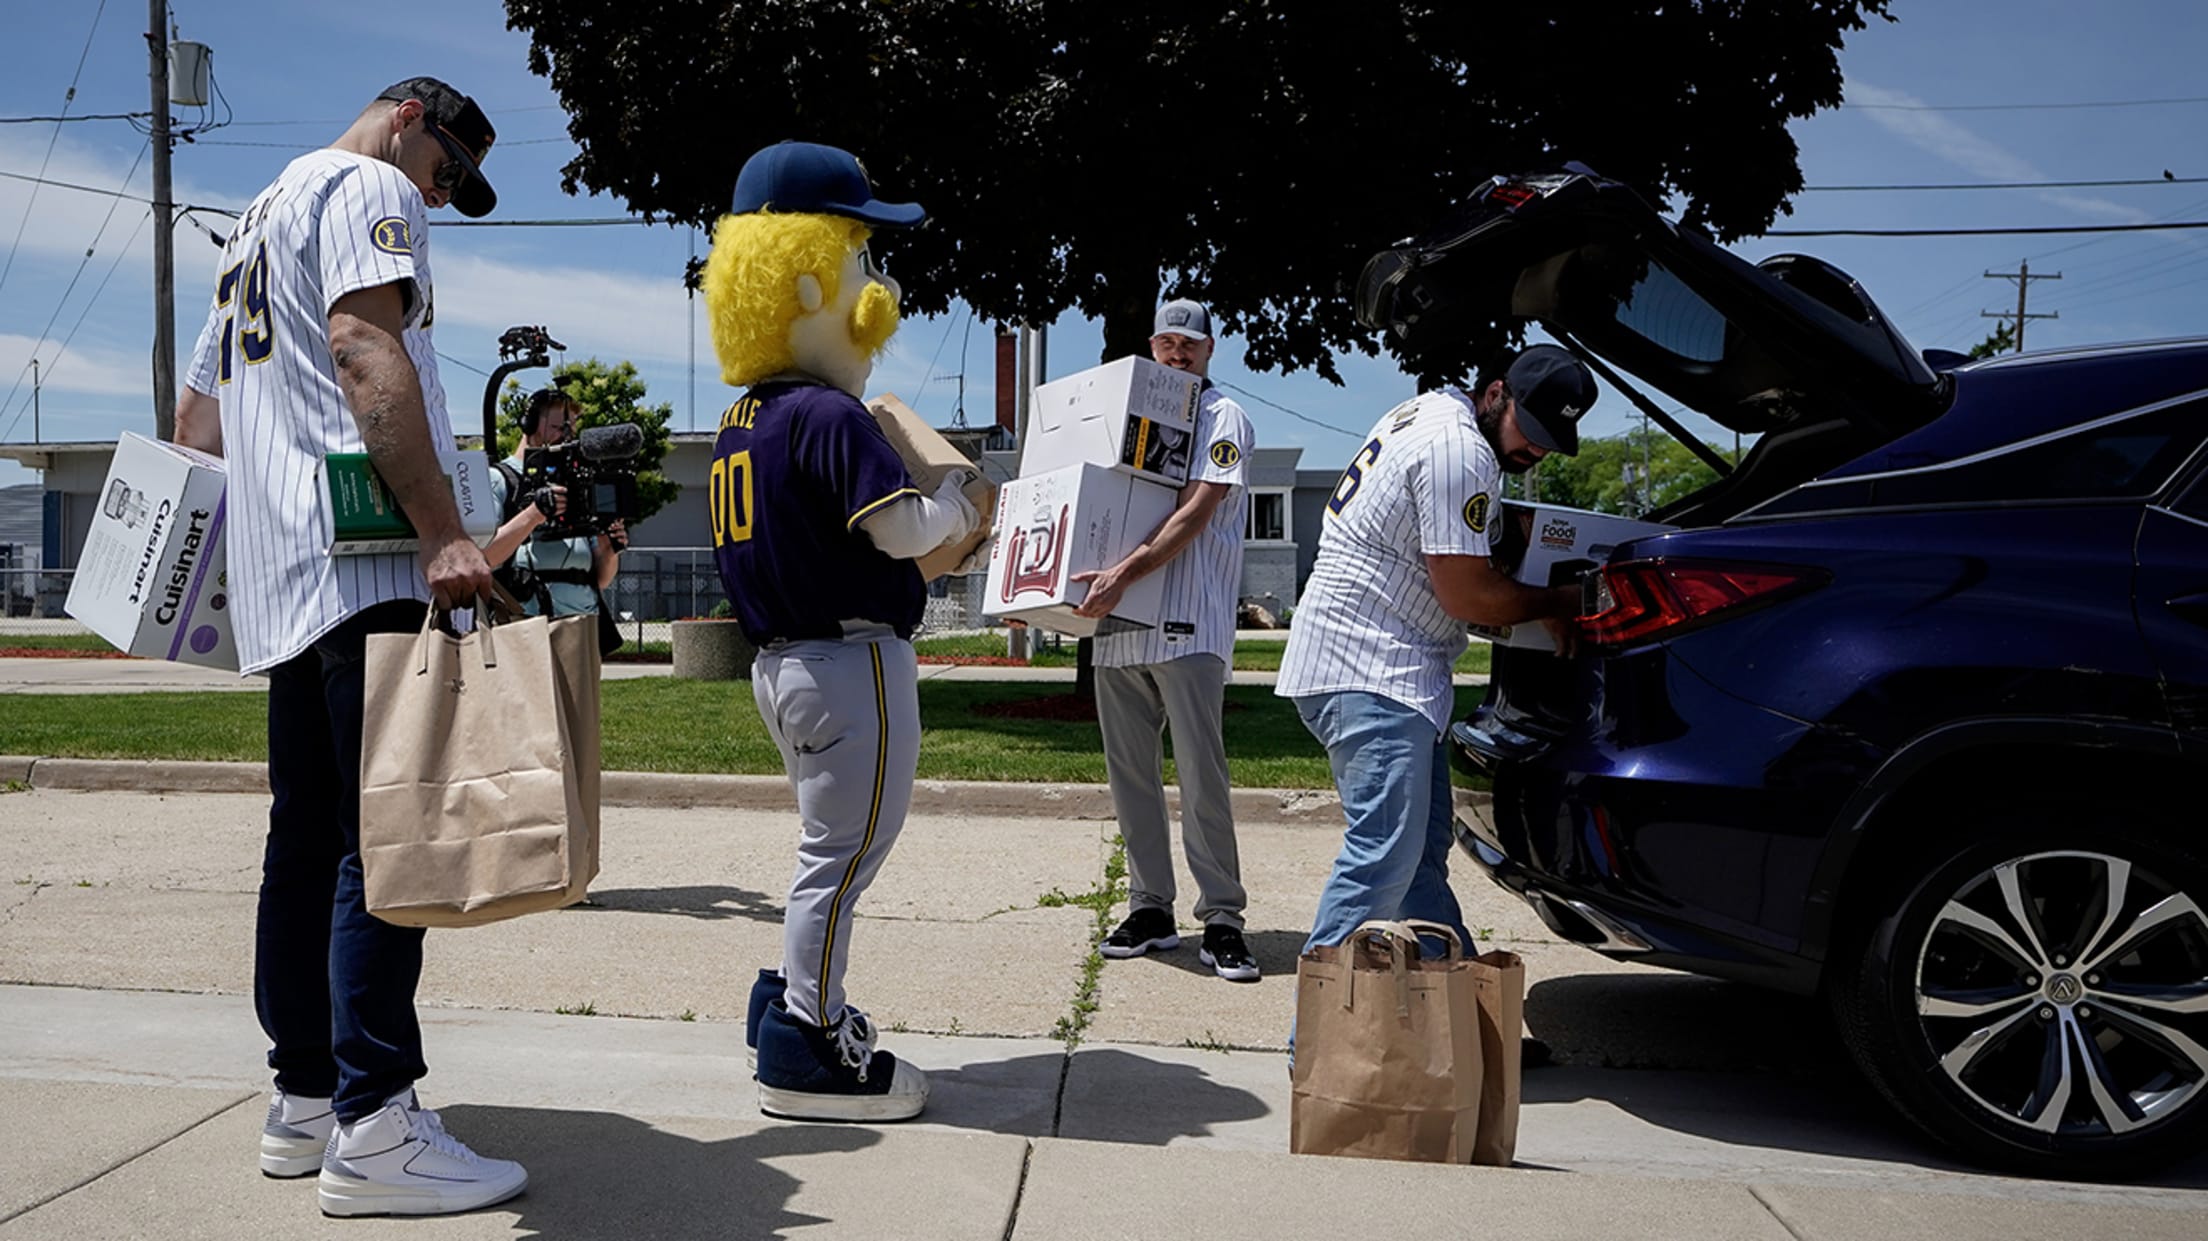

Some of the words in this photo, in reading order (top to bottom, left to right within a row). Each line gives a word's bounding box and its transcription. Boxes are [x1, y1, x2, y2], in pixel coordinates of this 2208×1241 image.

[218, 236, 274, 385] 79
[456, 461, 475, 516] COLAVITA
[709, 450, 754, 548] 00
[1542, 524, 1577, 540] Foodi
[127, 499, 172, 604] Cuisinart
[155, 507, 210, 625] Cuisinart
